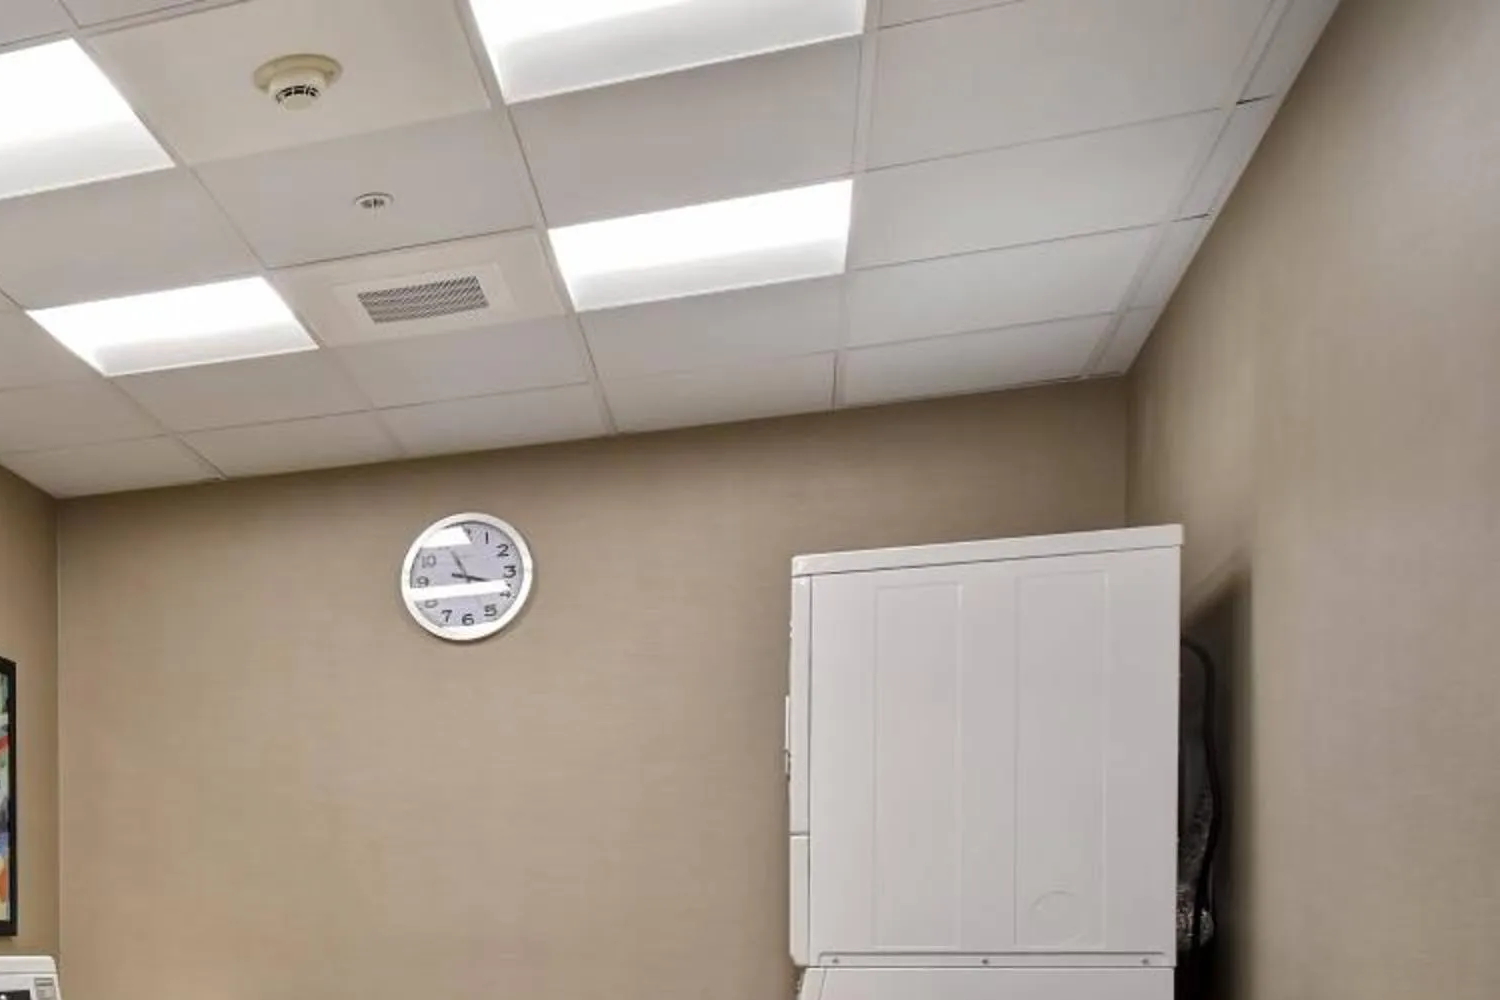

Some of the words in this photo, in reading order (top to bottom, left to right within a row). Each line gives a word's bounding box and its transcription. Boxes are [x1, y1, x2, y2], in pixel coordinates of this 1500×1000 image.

[496, 543, 509, 557] 2
[421, 555, 437, 569] 10
[503, 565, 517, 579] 3
[416, 576, 429, 588] 9
[441, 609, 453, 623] 7
[483, 603, 497, 617] 5
[461, 613, 475, 626] 6
